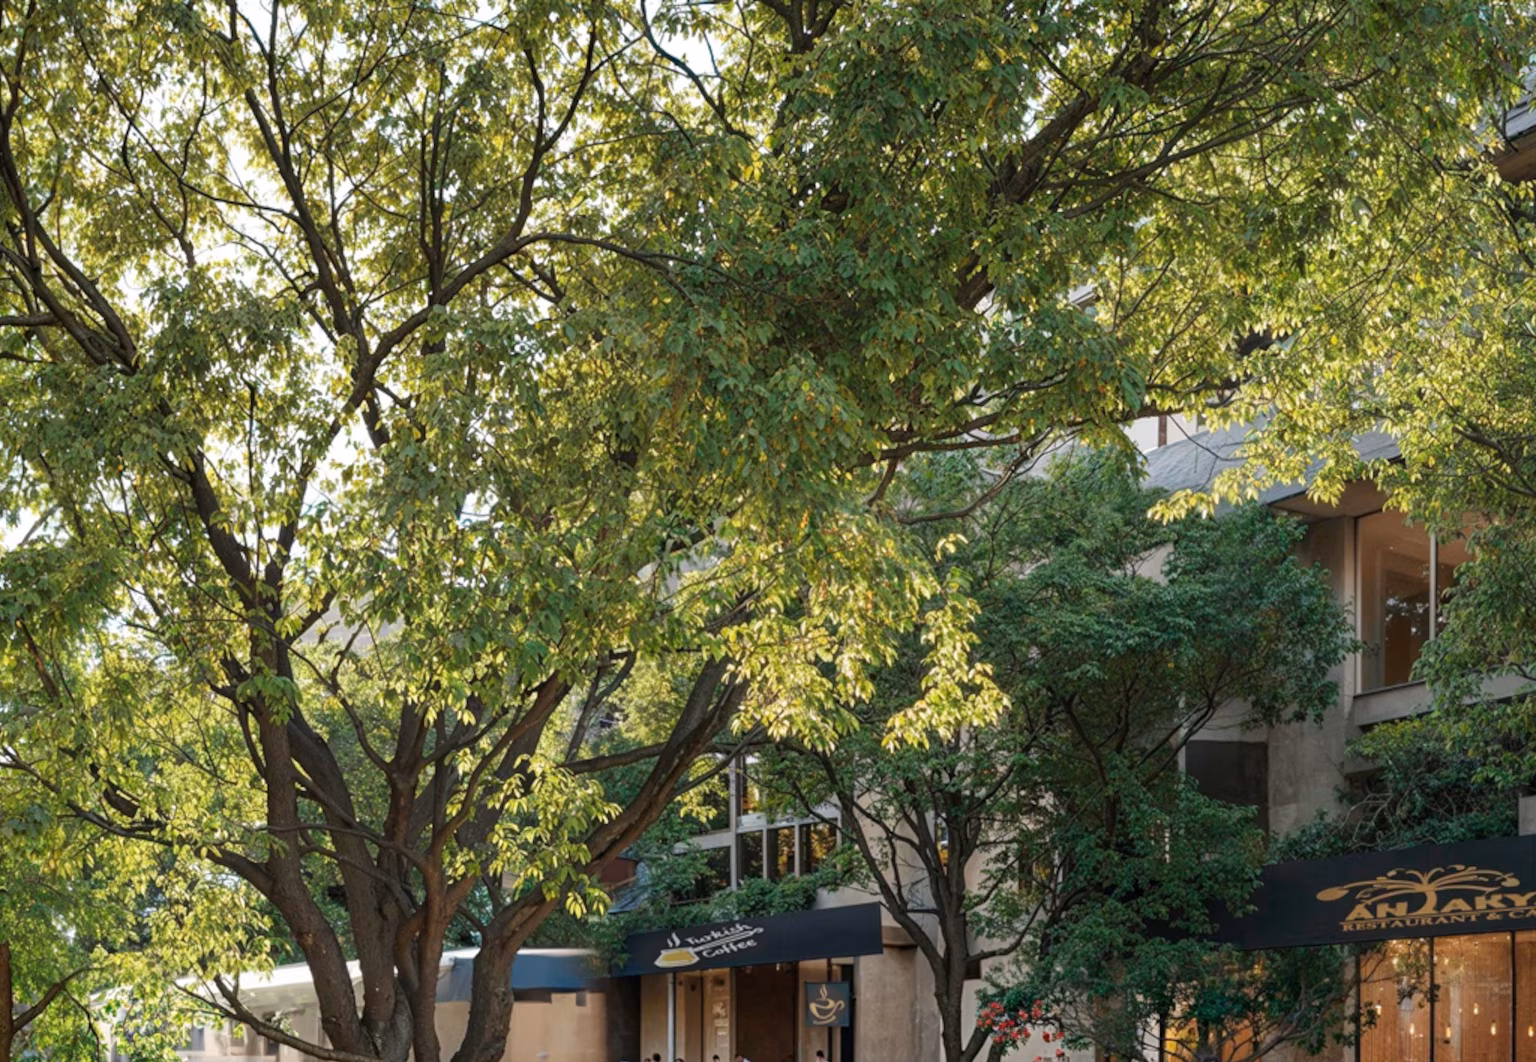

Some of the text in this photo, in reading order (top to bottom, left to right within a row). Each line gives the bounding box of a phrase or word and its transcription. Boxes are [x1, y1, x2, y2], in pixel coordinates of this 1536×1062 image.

[1343, 912, 1478, 932] RESTAURANT
[1486, 911, 1503, 921] &
[686, 923, 752, 945] Turkish
[702, 939, 757, 958] Coffee
